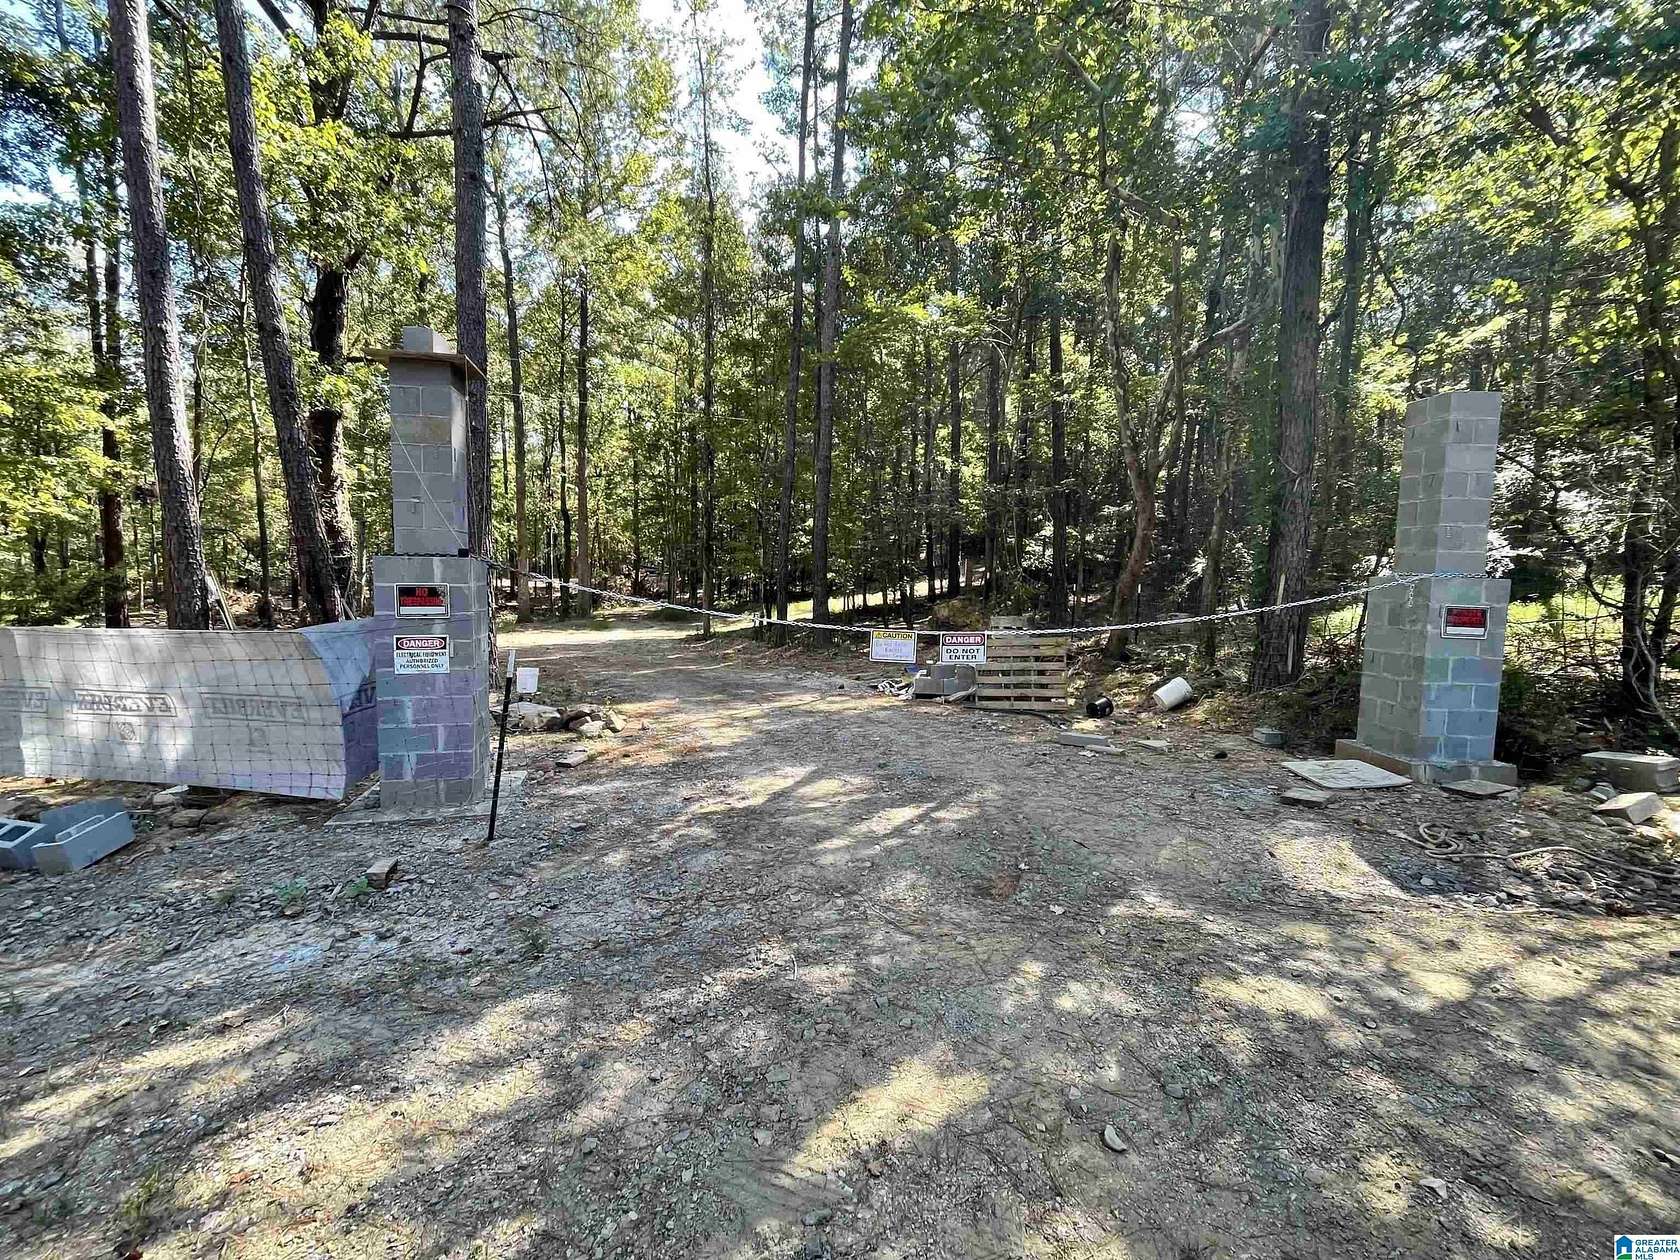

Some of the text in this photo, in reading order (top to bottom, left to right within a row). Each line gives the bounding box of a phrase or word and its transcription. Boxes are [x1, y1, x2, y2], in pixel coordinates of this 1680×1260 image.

[415, 587, 428, 597] NO
[403, 639, 441, 648] DANGER
[945, 636, 982, 644] DANGER
